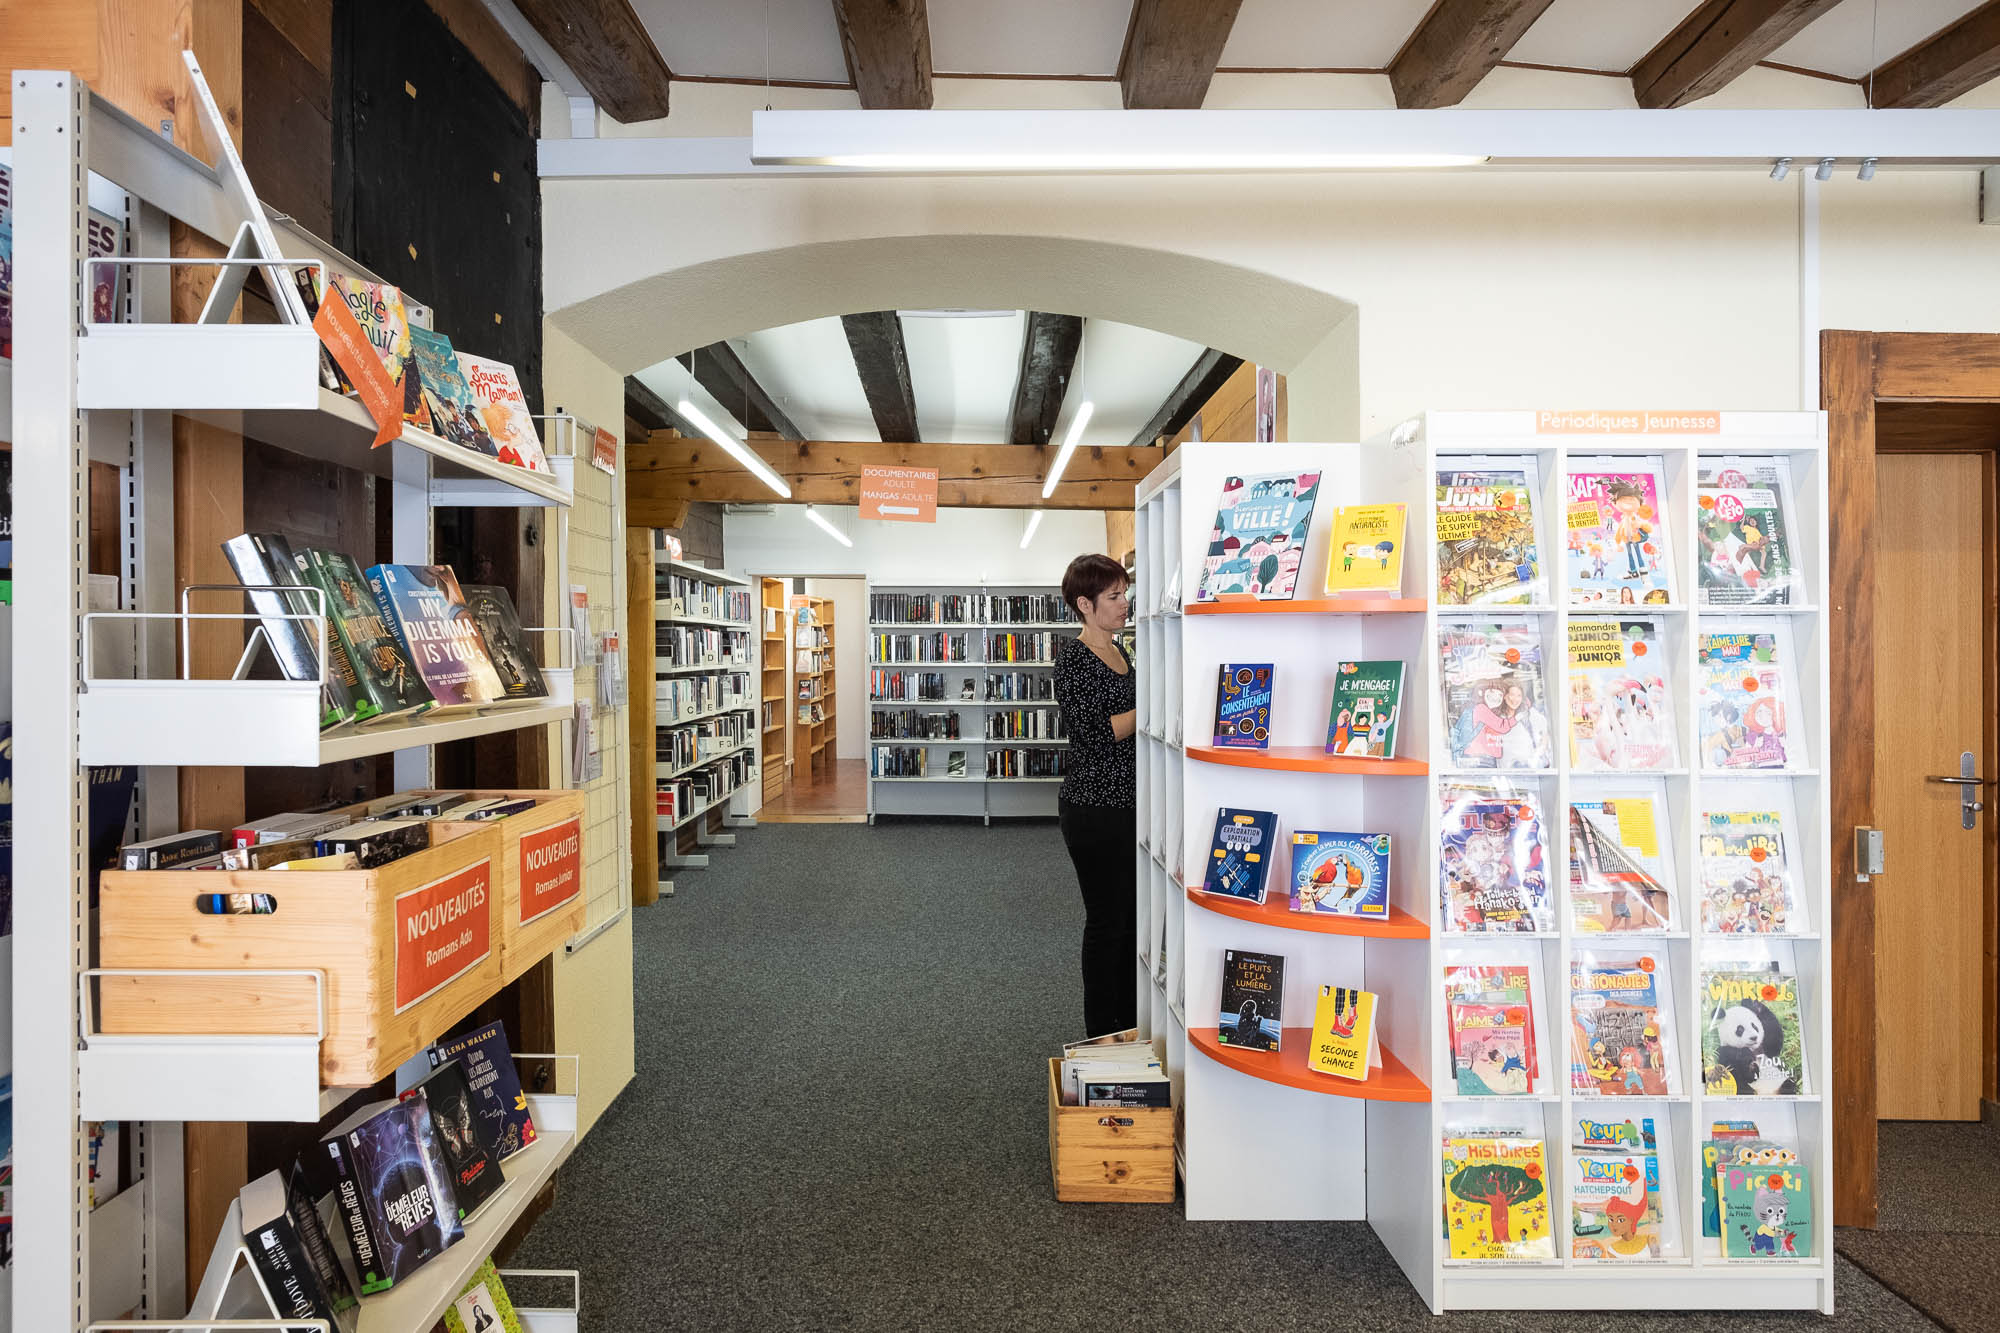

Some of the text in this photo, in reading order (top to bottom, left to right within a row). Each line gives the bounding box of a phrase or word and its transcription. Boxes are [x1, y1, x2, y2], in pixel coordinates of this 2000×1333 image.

[88, 218, 115, 253] ES
[360, 323, 398, 355] nuit
[1540, 409, 1716, 432] Périodiques Jeunesse
[863, 468, 936, 480] DOCUMENTAIRES
[883, 480, 917, 489] ADULTE
[1568, 475, 1603, 498] KAPI
[862, 490, 935, 503] MANGAS ADULTE
[1437, 488, 1528, 506] JUNIR
[1437, 522, 1479, 532] DE SURVIE
[1445, 514, 1472, 522] GUIDE
[418, 599, 443, 618] MY
[674, 602, 709, 614] A B
[406, 618, 478, 641] DILEMMA
[1568, 624, 1617, 632] alamandre
[421, 642, 441, 664] IS
[444, 641, 475, 662] YOU
[708, 654, 714, 662] D
[1577, 652, 1621, 663] JUNIOR
[1243, 686, 1250, 698] LE
[1340, 680, 1349, 690] JE
[1351, 680, 1391, 690] M'ENGAGE
[687, 706, 694, 714] C
[1221, 691, 1271, 716] CONSENTEMENT
[1223, 826, 1260, 837] EXPLORATION
[526, 832, 578, 873] NOUVEAUTÉS
[535, 869, 573, 897] Romans Junior
[407, 877, 485, 943] NOUVEAUTÉS
[426, 929, 473, 968] Romans Ado
[1244, 971, 1265, 980] ET LA
[1249, 963, 1272, 973] PUITS
[1504, 972, 1528, 990] LIRE
[1709, 979, 1794, 1001] WAKU
[446, 1029, 497, 1056] LENA WALKER
[1320, 1044, 1359, 1059] SECONDE
[1321, 1056, 1355, 1070] CHANCE
[1579, 1119, 1631, 1144] Youp
[1578, 1158, 1632, 1183] Youp
[1574, 1185, 1633, 1194] HATCHEPSOUT
[1729, 1170, 1802, 1192] Picti
[340, 1180, 359, 1209] RÊVES
[386, 1184, 430, 1222] DÉMÊLEUR
[400, 1198, 434, 1231] RÊVES
[349, 1215, 373, 1259] DÉMÊLEUR
[266, 1248, 282, 1270] SHEL
